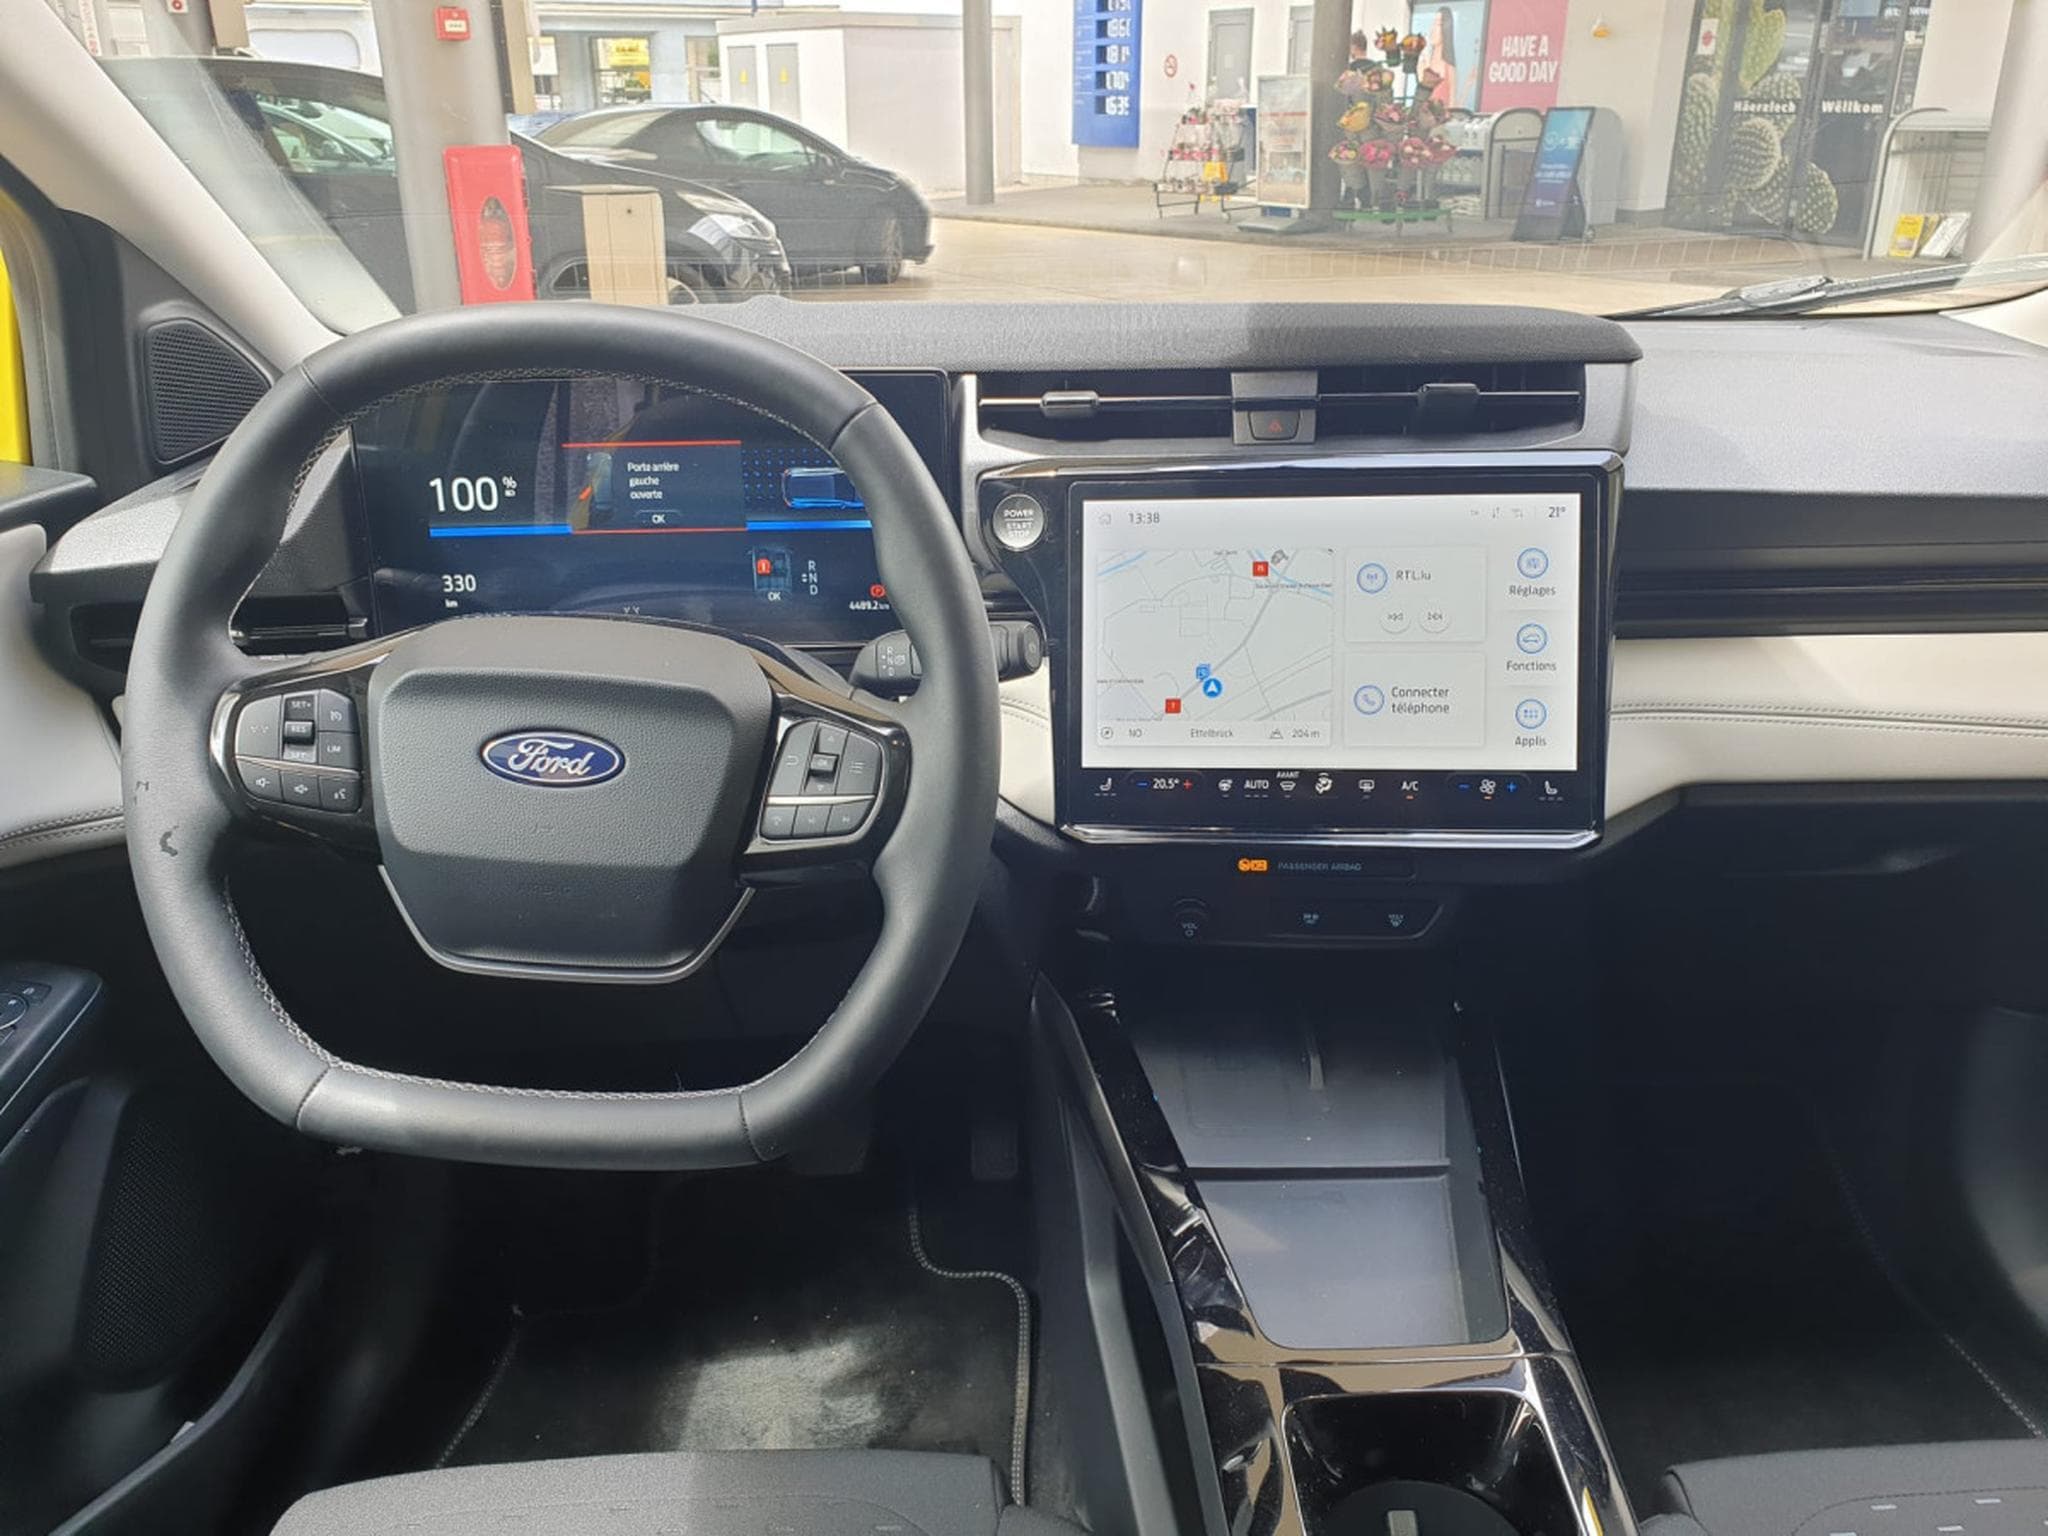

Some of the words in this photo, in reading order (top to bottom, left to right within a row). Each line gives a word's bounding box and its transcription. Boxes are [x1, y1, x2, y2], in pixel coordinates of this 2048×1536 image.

[1501, 35, 1537, 58] HAVE
[1537, 34, 1549, 57] A
[1488, 61, 1526, 83] GOOD
[1529, 60, 1559, 83] DAY
[1821, 99, 1884, 114] Wëllkom
[626, 461, 648, 473] Porte
[628, 475, 661, 488] gauche
[629, 489, 664, 500] ouverte
[651, 514, 666, 524] OK
[1003, 508, 1034, 518] POWER
[1127, 512, 1161, 524] 13:38
[1006, 521, 1033, 531] START
[807, 560, 817, 572] R
[808, 573, 818, 583] N
[1395, 569, 1432, 581] RTL.lu
[441, 573, 477, 593] 330
[809, 584, 818, 596] D
[1508, 583, 1557, 597] Réglages
[767, 592, 782, 601] OK
[1505, 660, 1558, 672] Fonctions
[1390, 686, 1450, 699] Connecter
[1390, 702, 1451, 715] téléphone
[1128, 728, 1143, 738] NO
[1291, 729, 1310, 738] 204
[1514, 735, 1548, 748] Applis
[507, 738, 596, 776] Ford
[1152, 777, 1180, 790] 20.5°
[1243, 779, 1270, 790] AUTO
[1401, 780, 1419, 792] A/C
